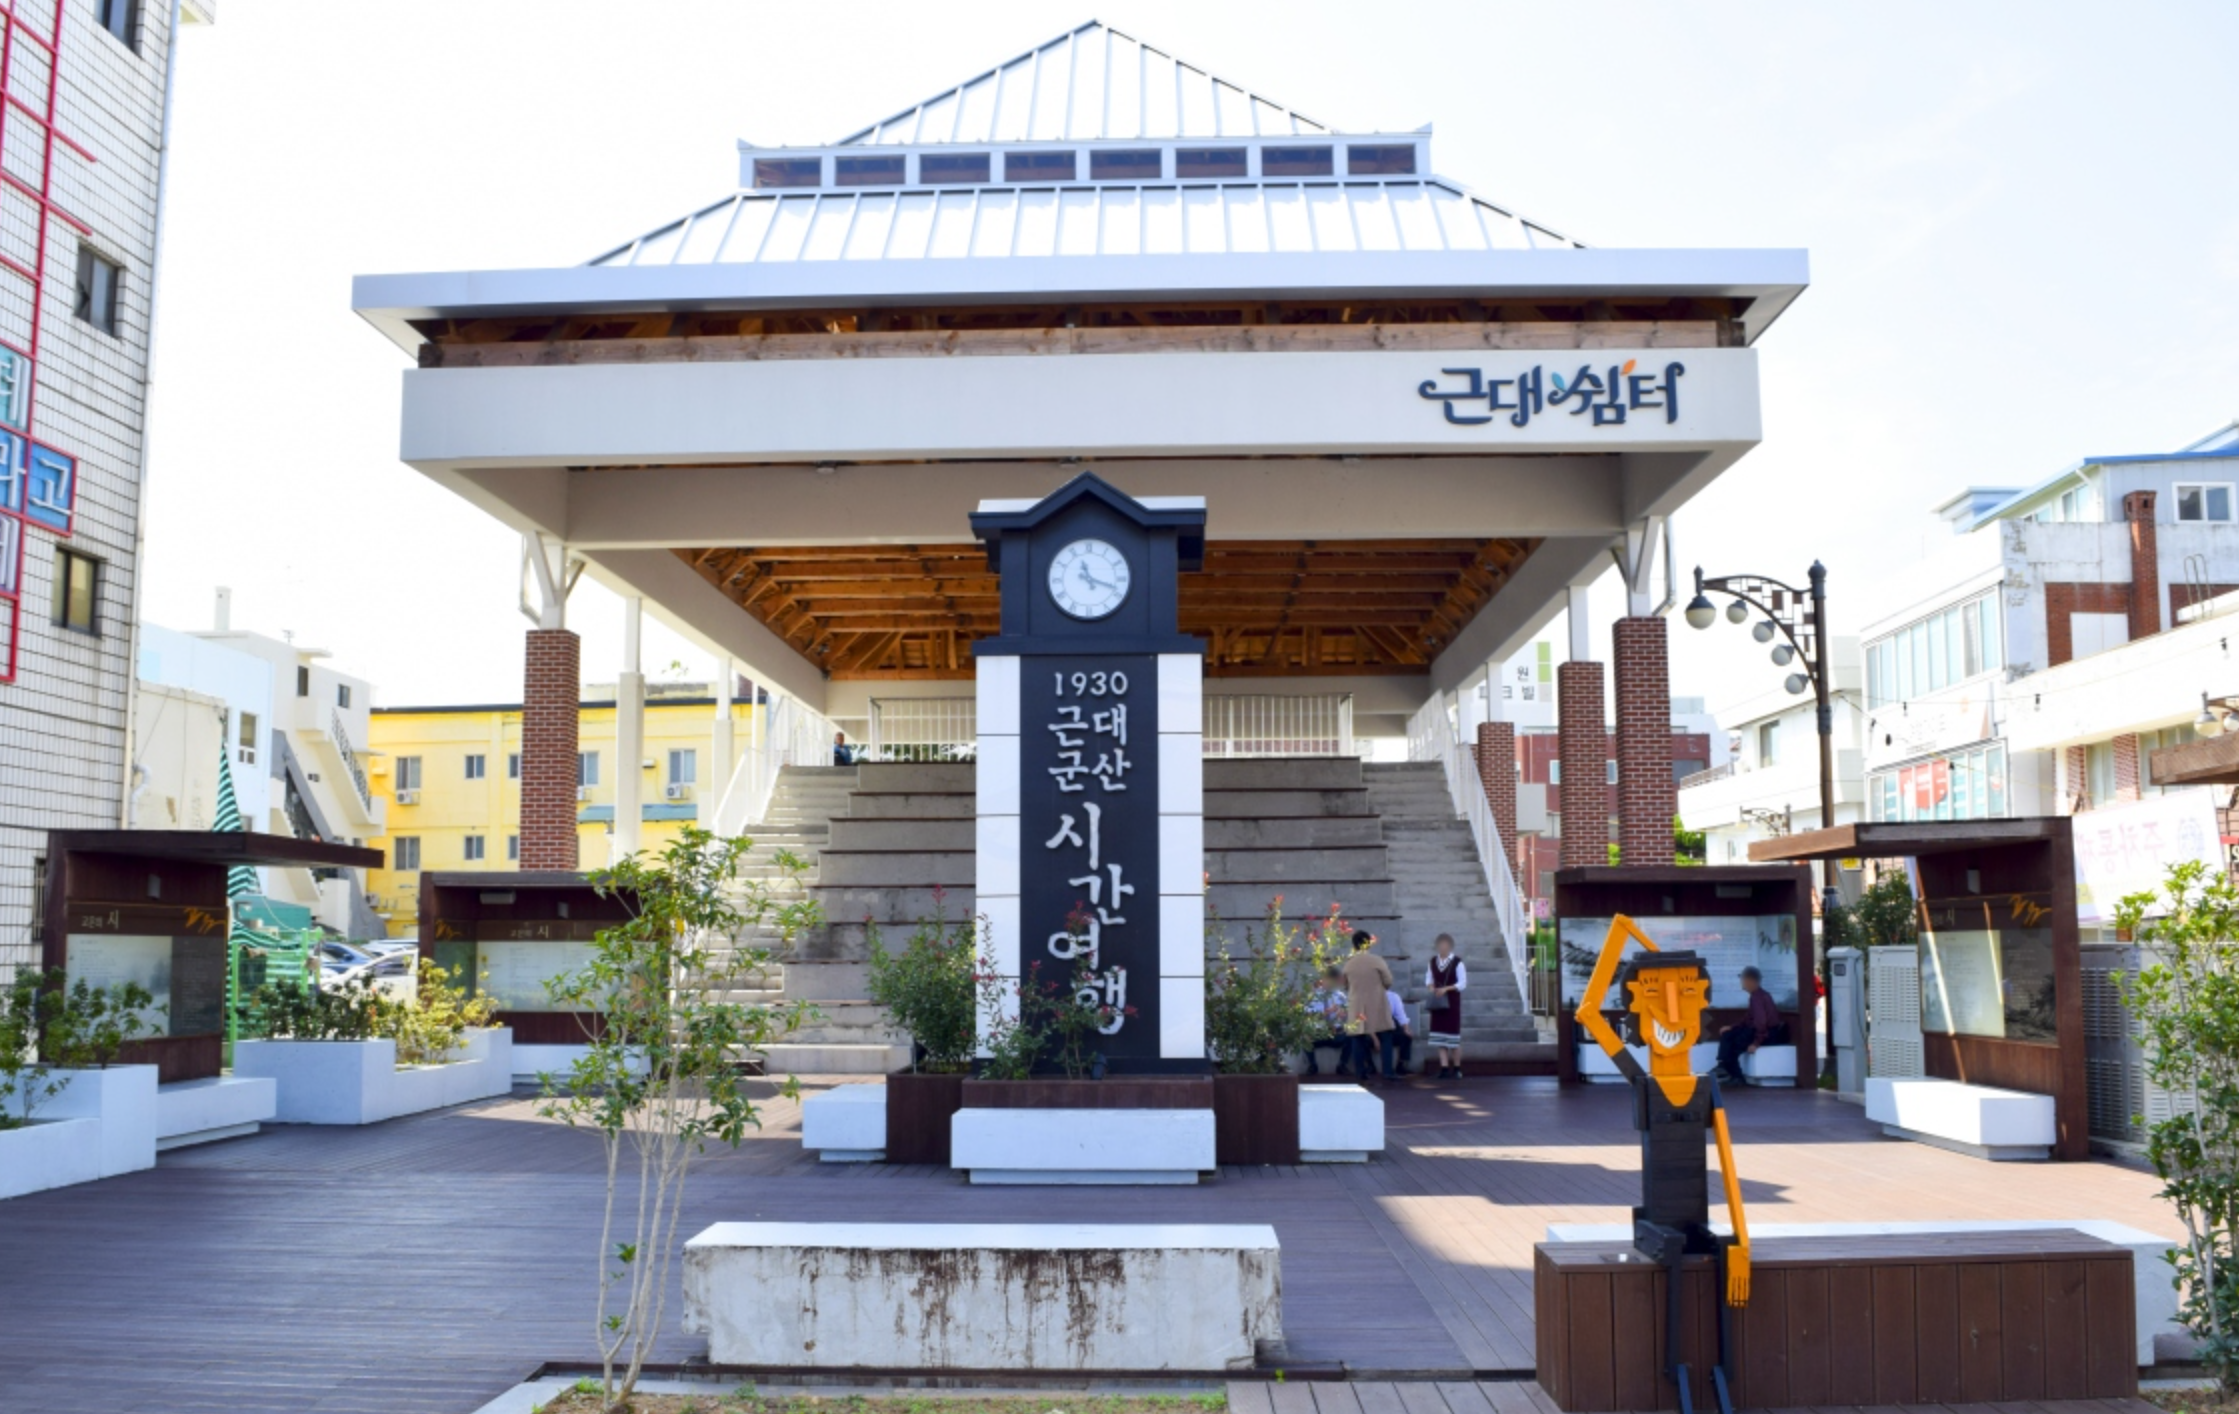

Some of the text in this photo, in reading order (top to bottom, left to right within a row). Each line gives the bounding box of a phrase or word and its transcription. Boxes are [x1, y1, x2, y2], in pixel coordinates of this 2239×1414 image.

[1054, 670, 1129, 696] 1930
[1047, 702, 1129, 747] 근대
[1047, 747, 1132, 792] 군산
[107, 909, 119, 929] 시
